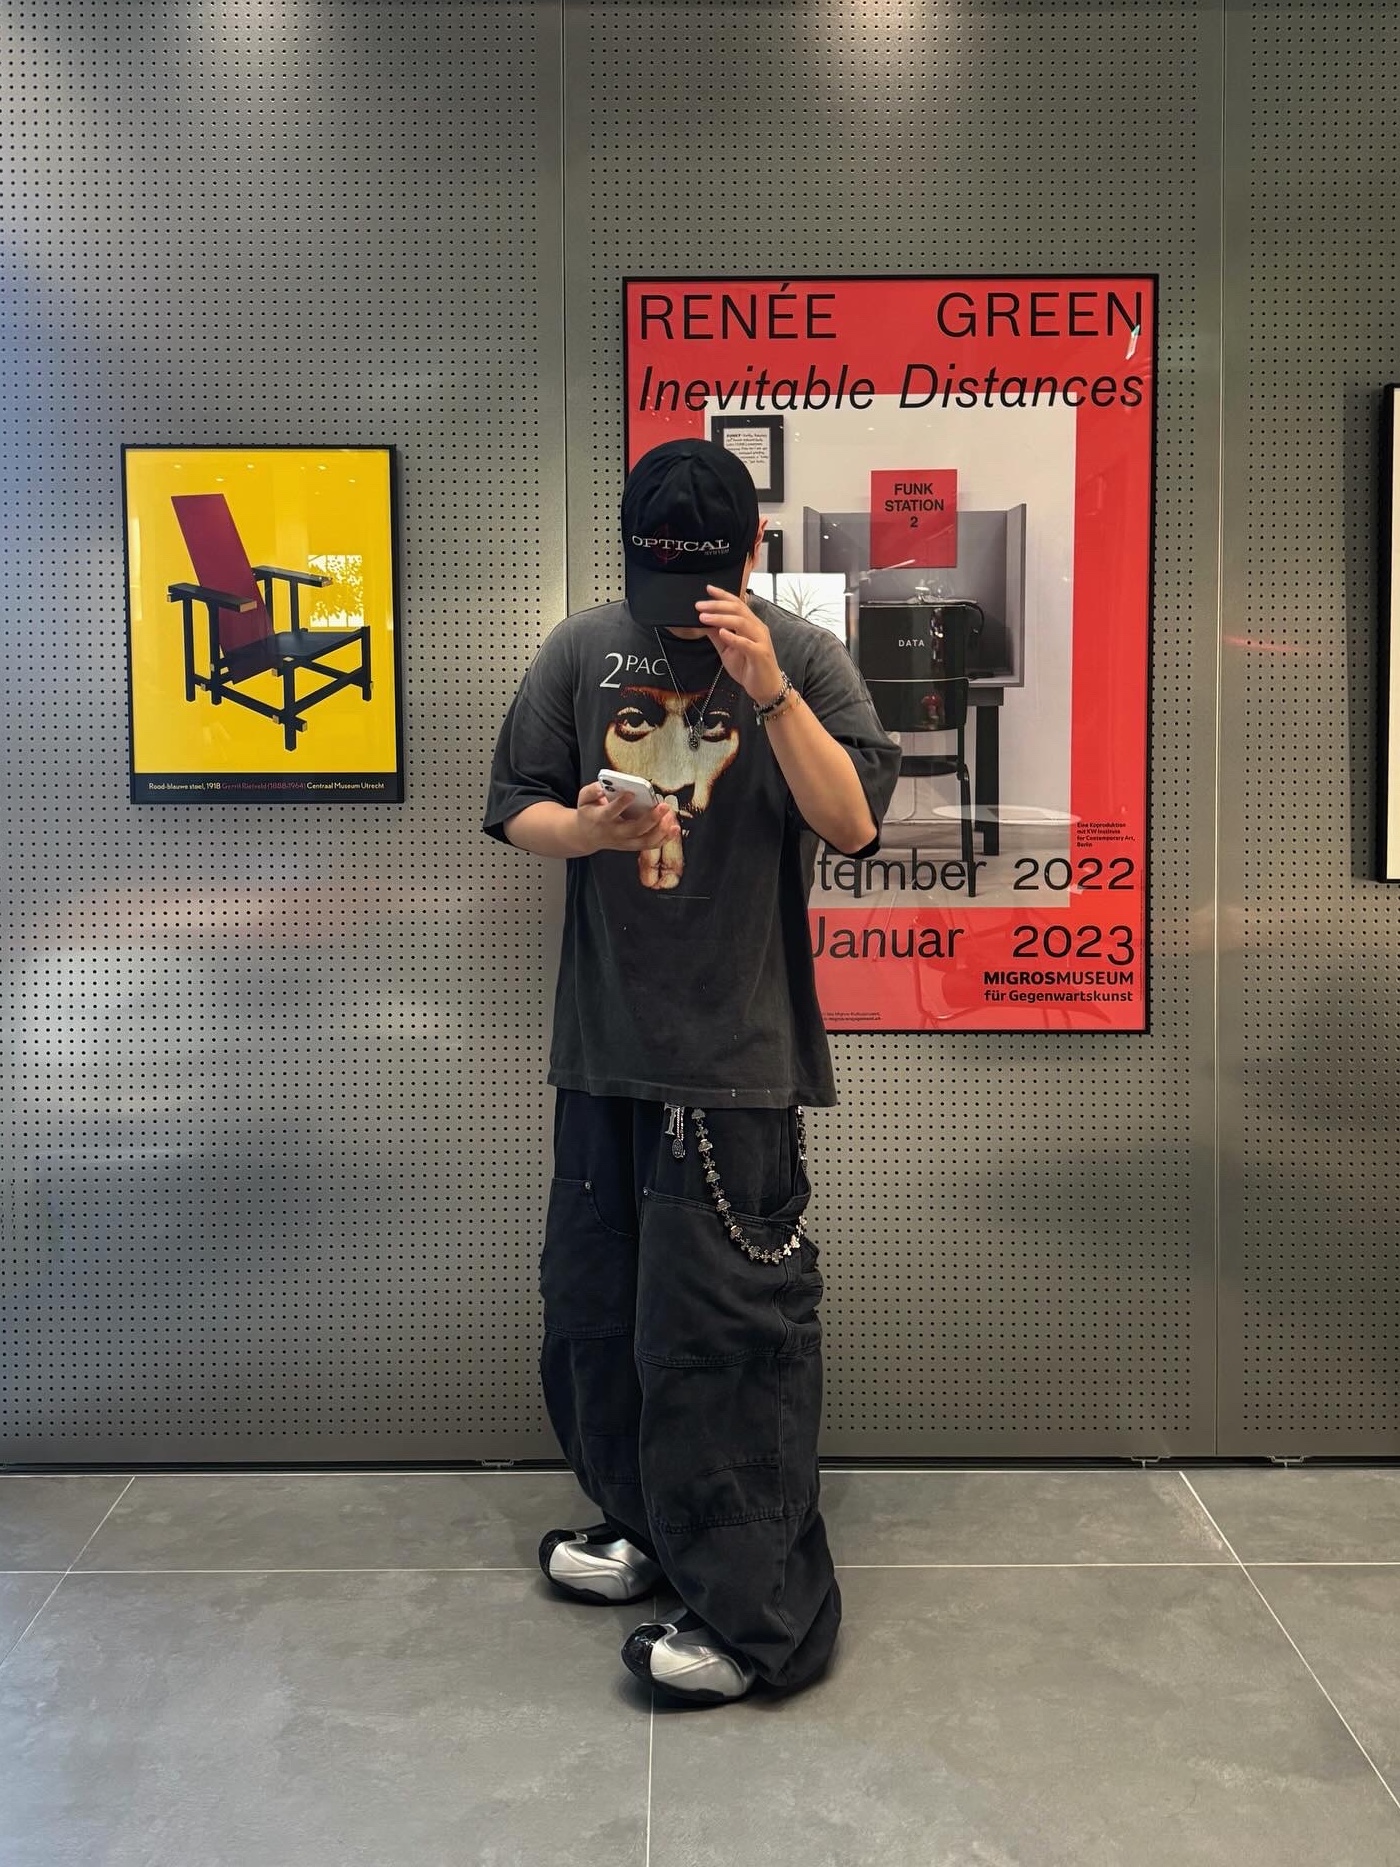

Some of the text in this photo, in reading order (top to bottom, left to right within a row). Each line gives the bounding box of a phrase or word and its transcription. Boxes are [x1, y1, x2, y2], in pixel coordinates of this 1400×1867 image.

[640, 283, 1142, 340] RENÉE GREEN
[639, 363, 1144, 411] Inevitable Distances
[894, 482, 934, 495] FUNK
[885, 498, 945, 512] STATION
[910, 516, 919, 528] 2
[632, 535, 730, 552] OPTICAL
[898, 639, 925, 648] DATA
[599, 652, 668, 689] 2PAC
[206, 782, 221, 790] 1918
[306, 781, 333, 790] Centraal
[334, 781, 360, 790] Museum
[360, 781, 385, 790] Utrecht
[816, 847, 1135, 891] tember 2022
[812, 916, 1135, 966] Januar 2023
[984, 971, 1134, 985] MIGROSMUSEUM
[984, 989, 1134, 1003] für Gegenwartskunst
